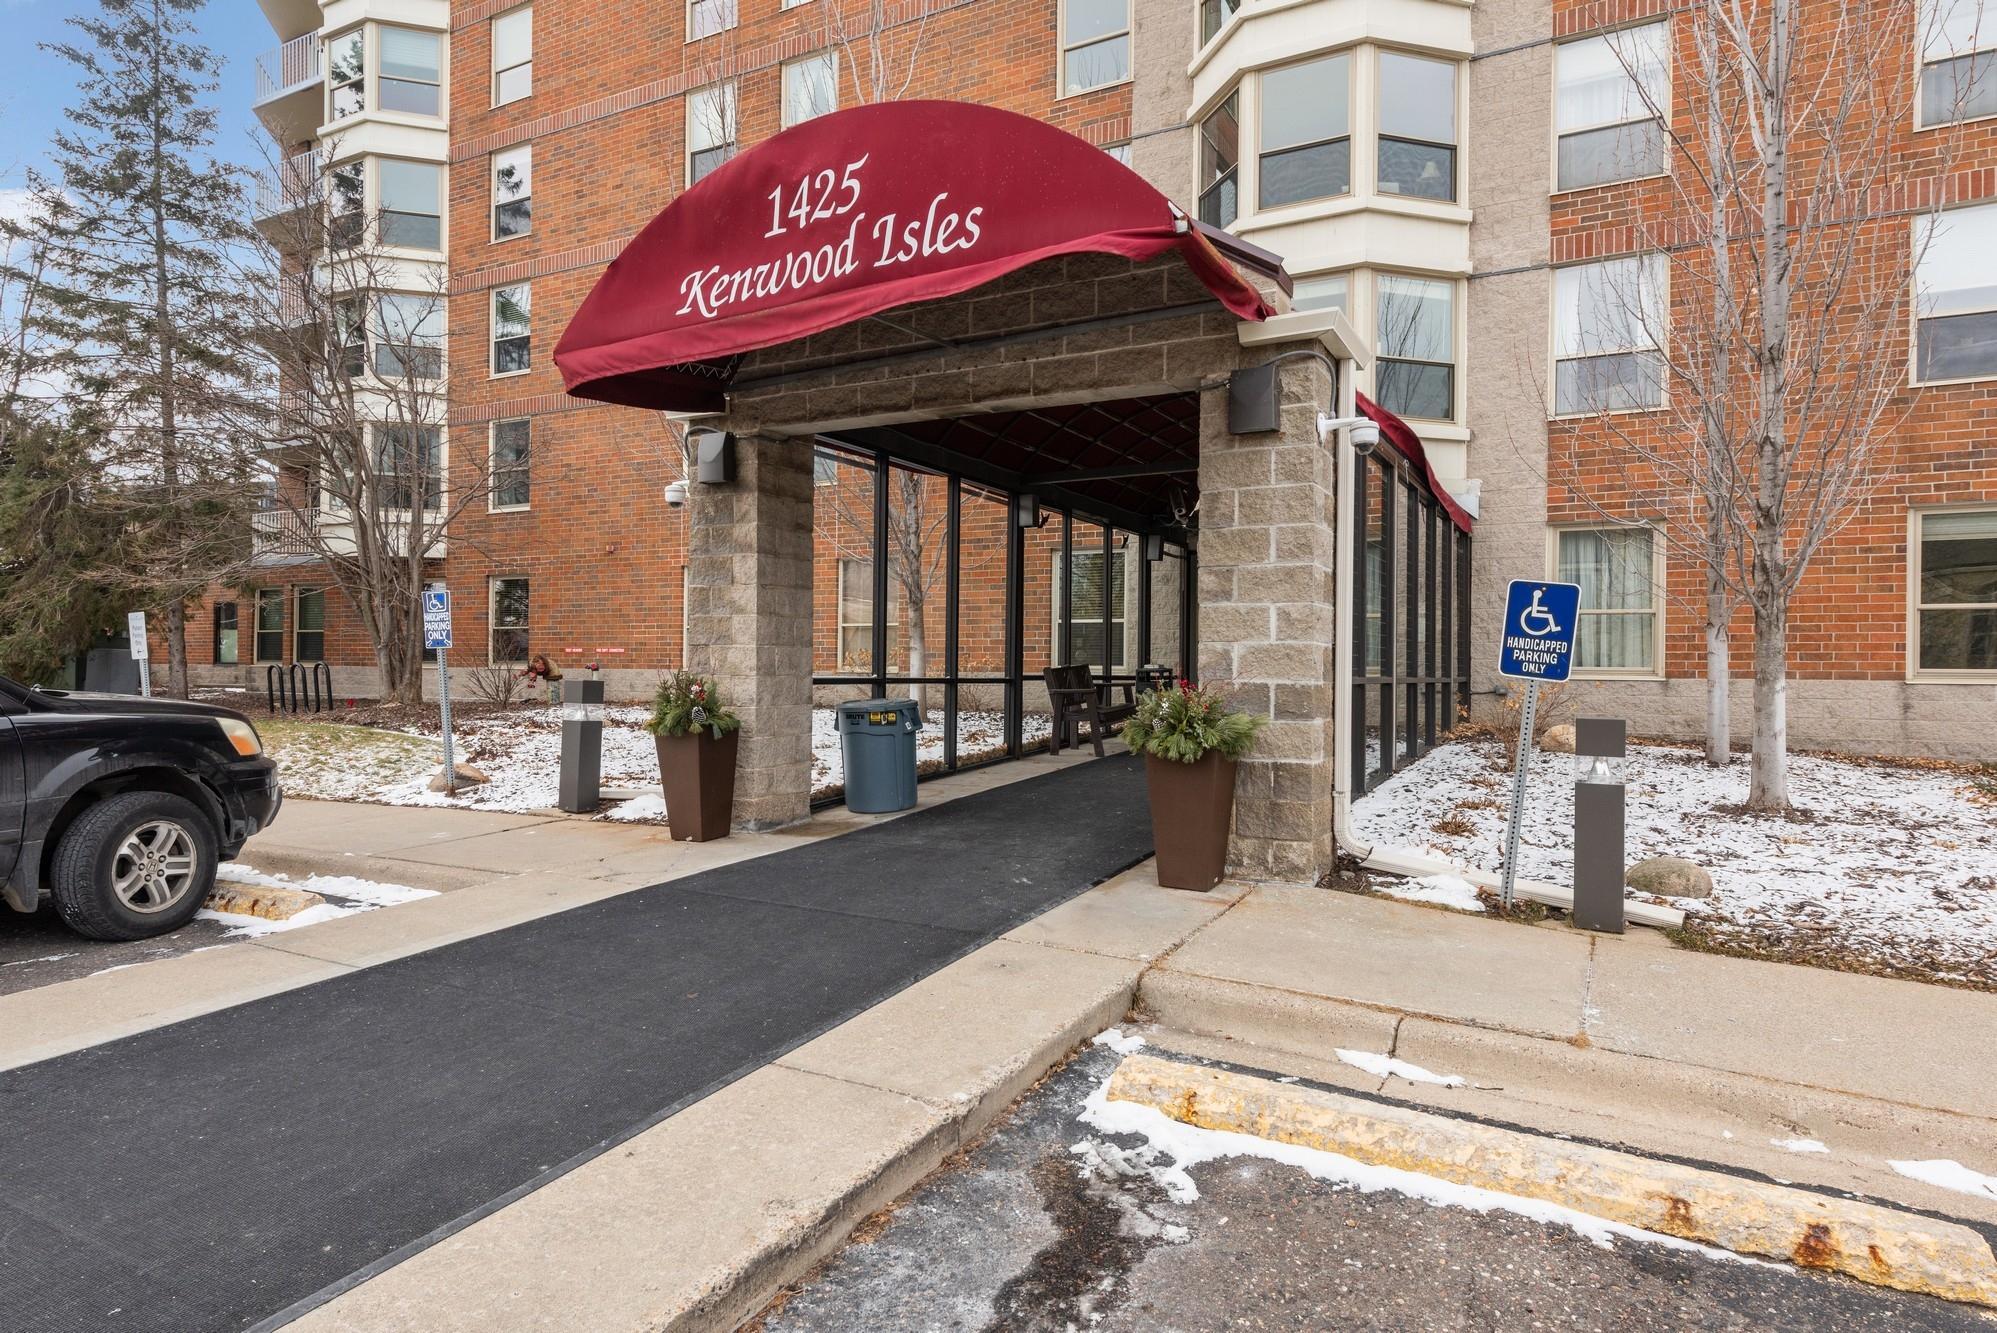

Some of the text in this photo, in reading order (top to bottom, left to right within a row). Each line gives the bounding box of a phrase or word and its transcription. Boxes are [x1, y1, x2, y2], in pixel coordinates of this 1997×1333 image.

[764, 152, 869, 239] 1425
[675, 192, 984, 318] Kenwood Isles
[424, 622, 450, 630] PARKING
[428, 630, 447, 640] ONLY
[1507, 636, 1568, 653] HANDICAPPED
[1513, 649, 1558, 664] PARKING
[1522, 662, 1546, 674] ONLY
